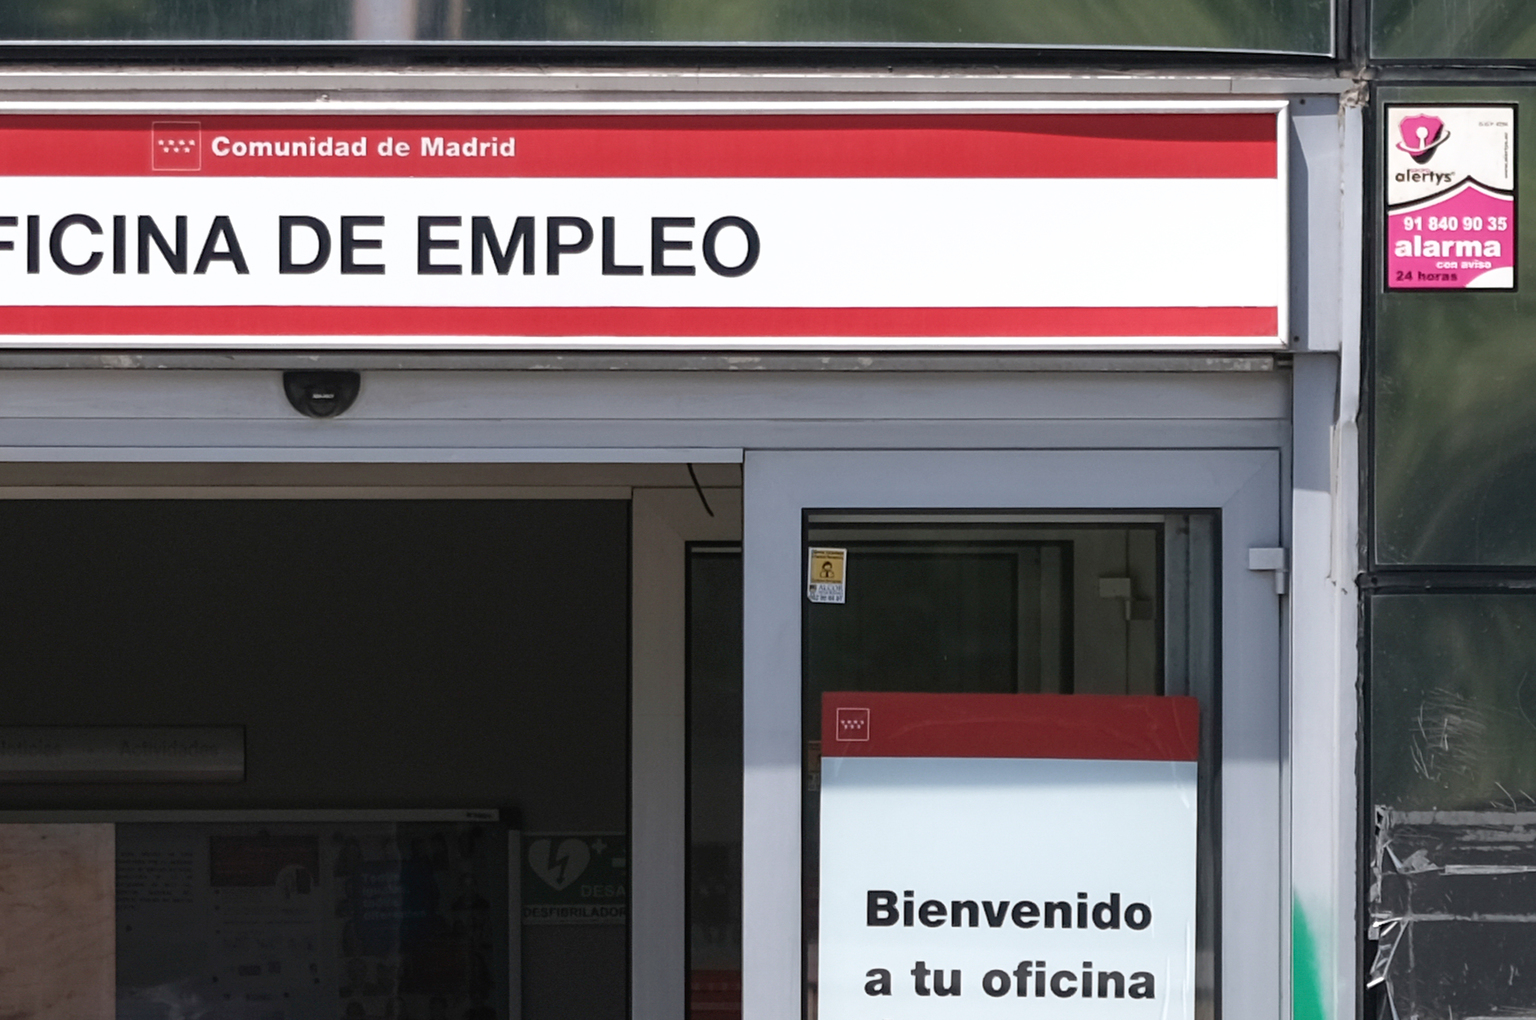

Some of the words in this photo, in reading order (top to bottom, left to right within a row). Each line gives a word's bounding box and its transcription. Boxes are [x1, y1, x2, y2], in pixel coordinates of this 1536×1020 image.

[211, 136, 366, 157] Comunidad
[377, 137, 410, 157] de
[421, 137, 516, 157] Madrid
[1403, 216, 1423, 231] 91
[1428, 216, 1458, 231] 840
[1463, 216, 1483, 231] 90
[1487, 216, 1508, 231] 35
[278, 215, 385, 276] DE
[417, 215, 762, 277] EMPLEO
[1394, 235, 1501, 258] alarma
[1435, 261, 1458, 269] con
[1461, 259, 1492, 269] aviso
[1396, 271, 1413, 281] 24
[1418, 271, 1458, 281] horas
[866, 889, 1152, 930] Bienvenido
[864, 967, 892, 997] a
[911, 960, 962, 997] tu
[982, 960, 1156, 999] oficina
